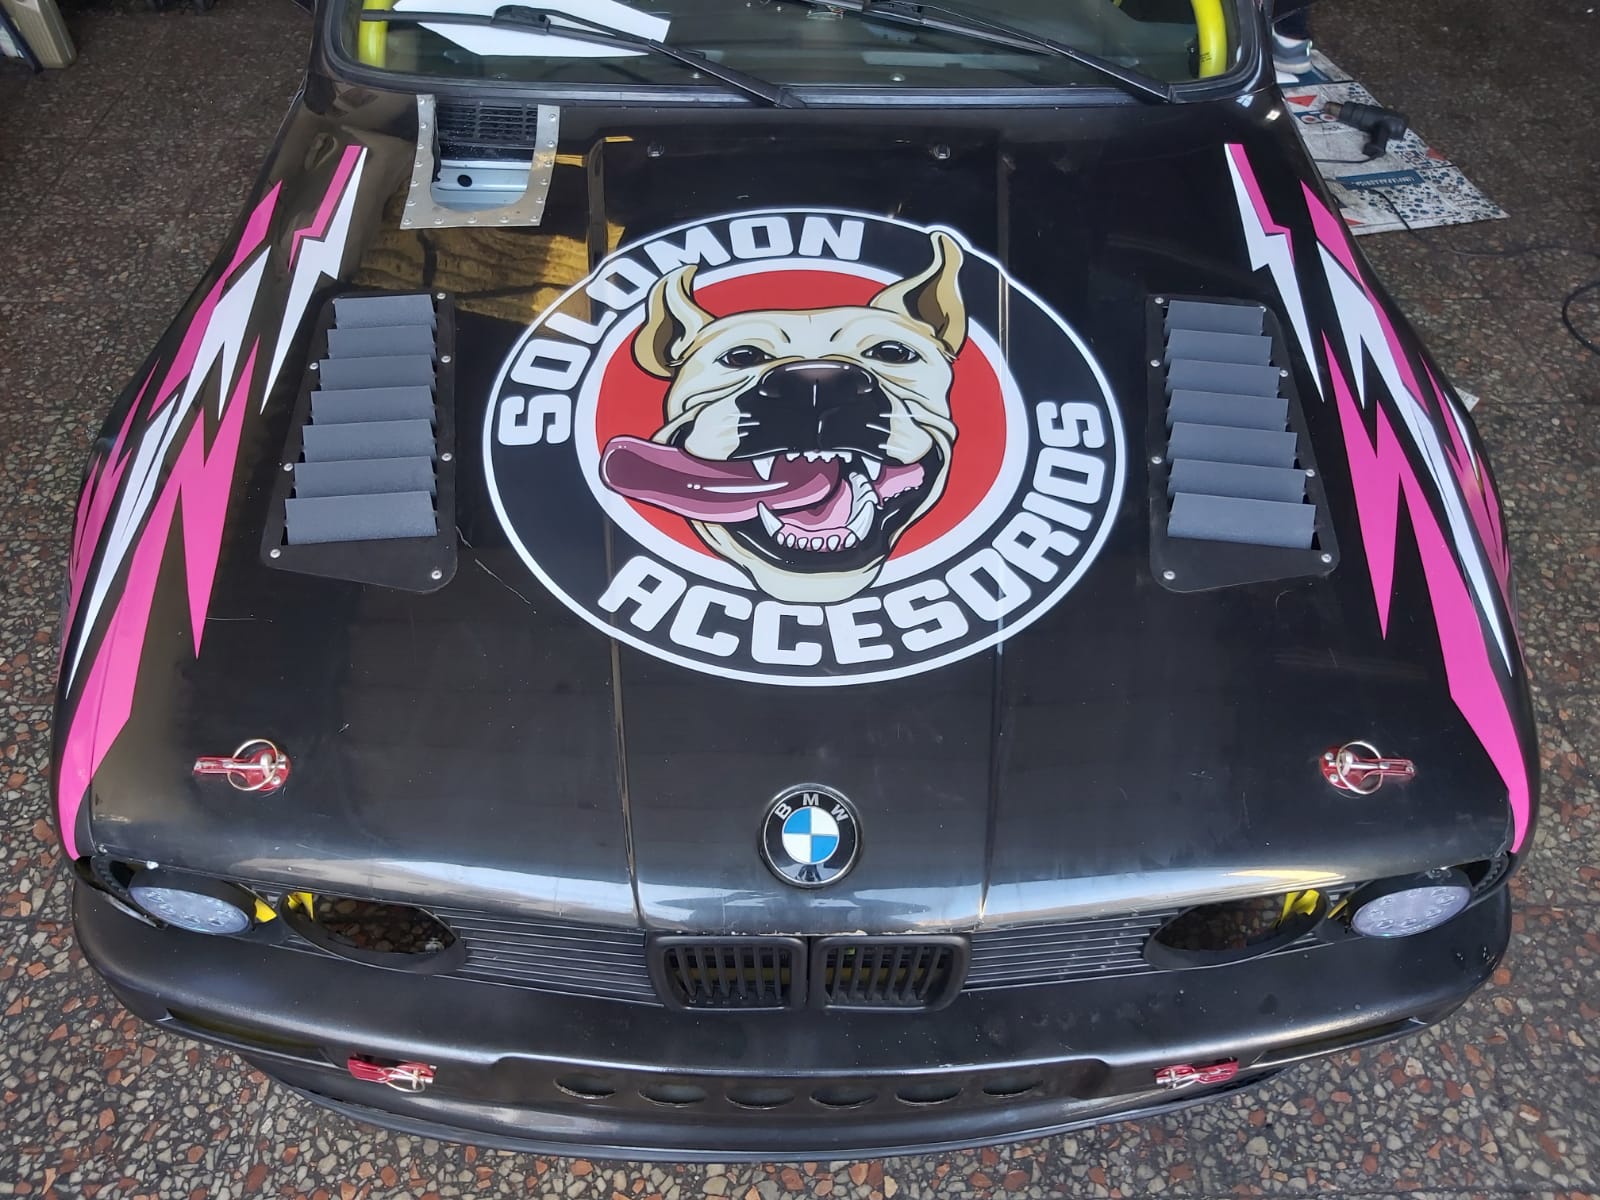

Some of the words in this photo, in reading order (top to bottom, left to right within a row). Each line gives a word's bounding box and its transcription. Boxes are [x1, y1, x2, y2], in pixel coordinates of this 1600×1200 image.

[498, 216, 865, 446] SOLOMON
[598, 401, 1106, 666] ACCESORIOS
[774, 793, 849, 822] BMW
